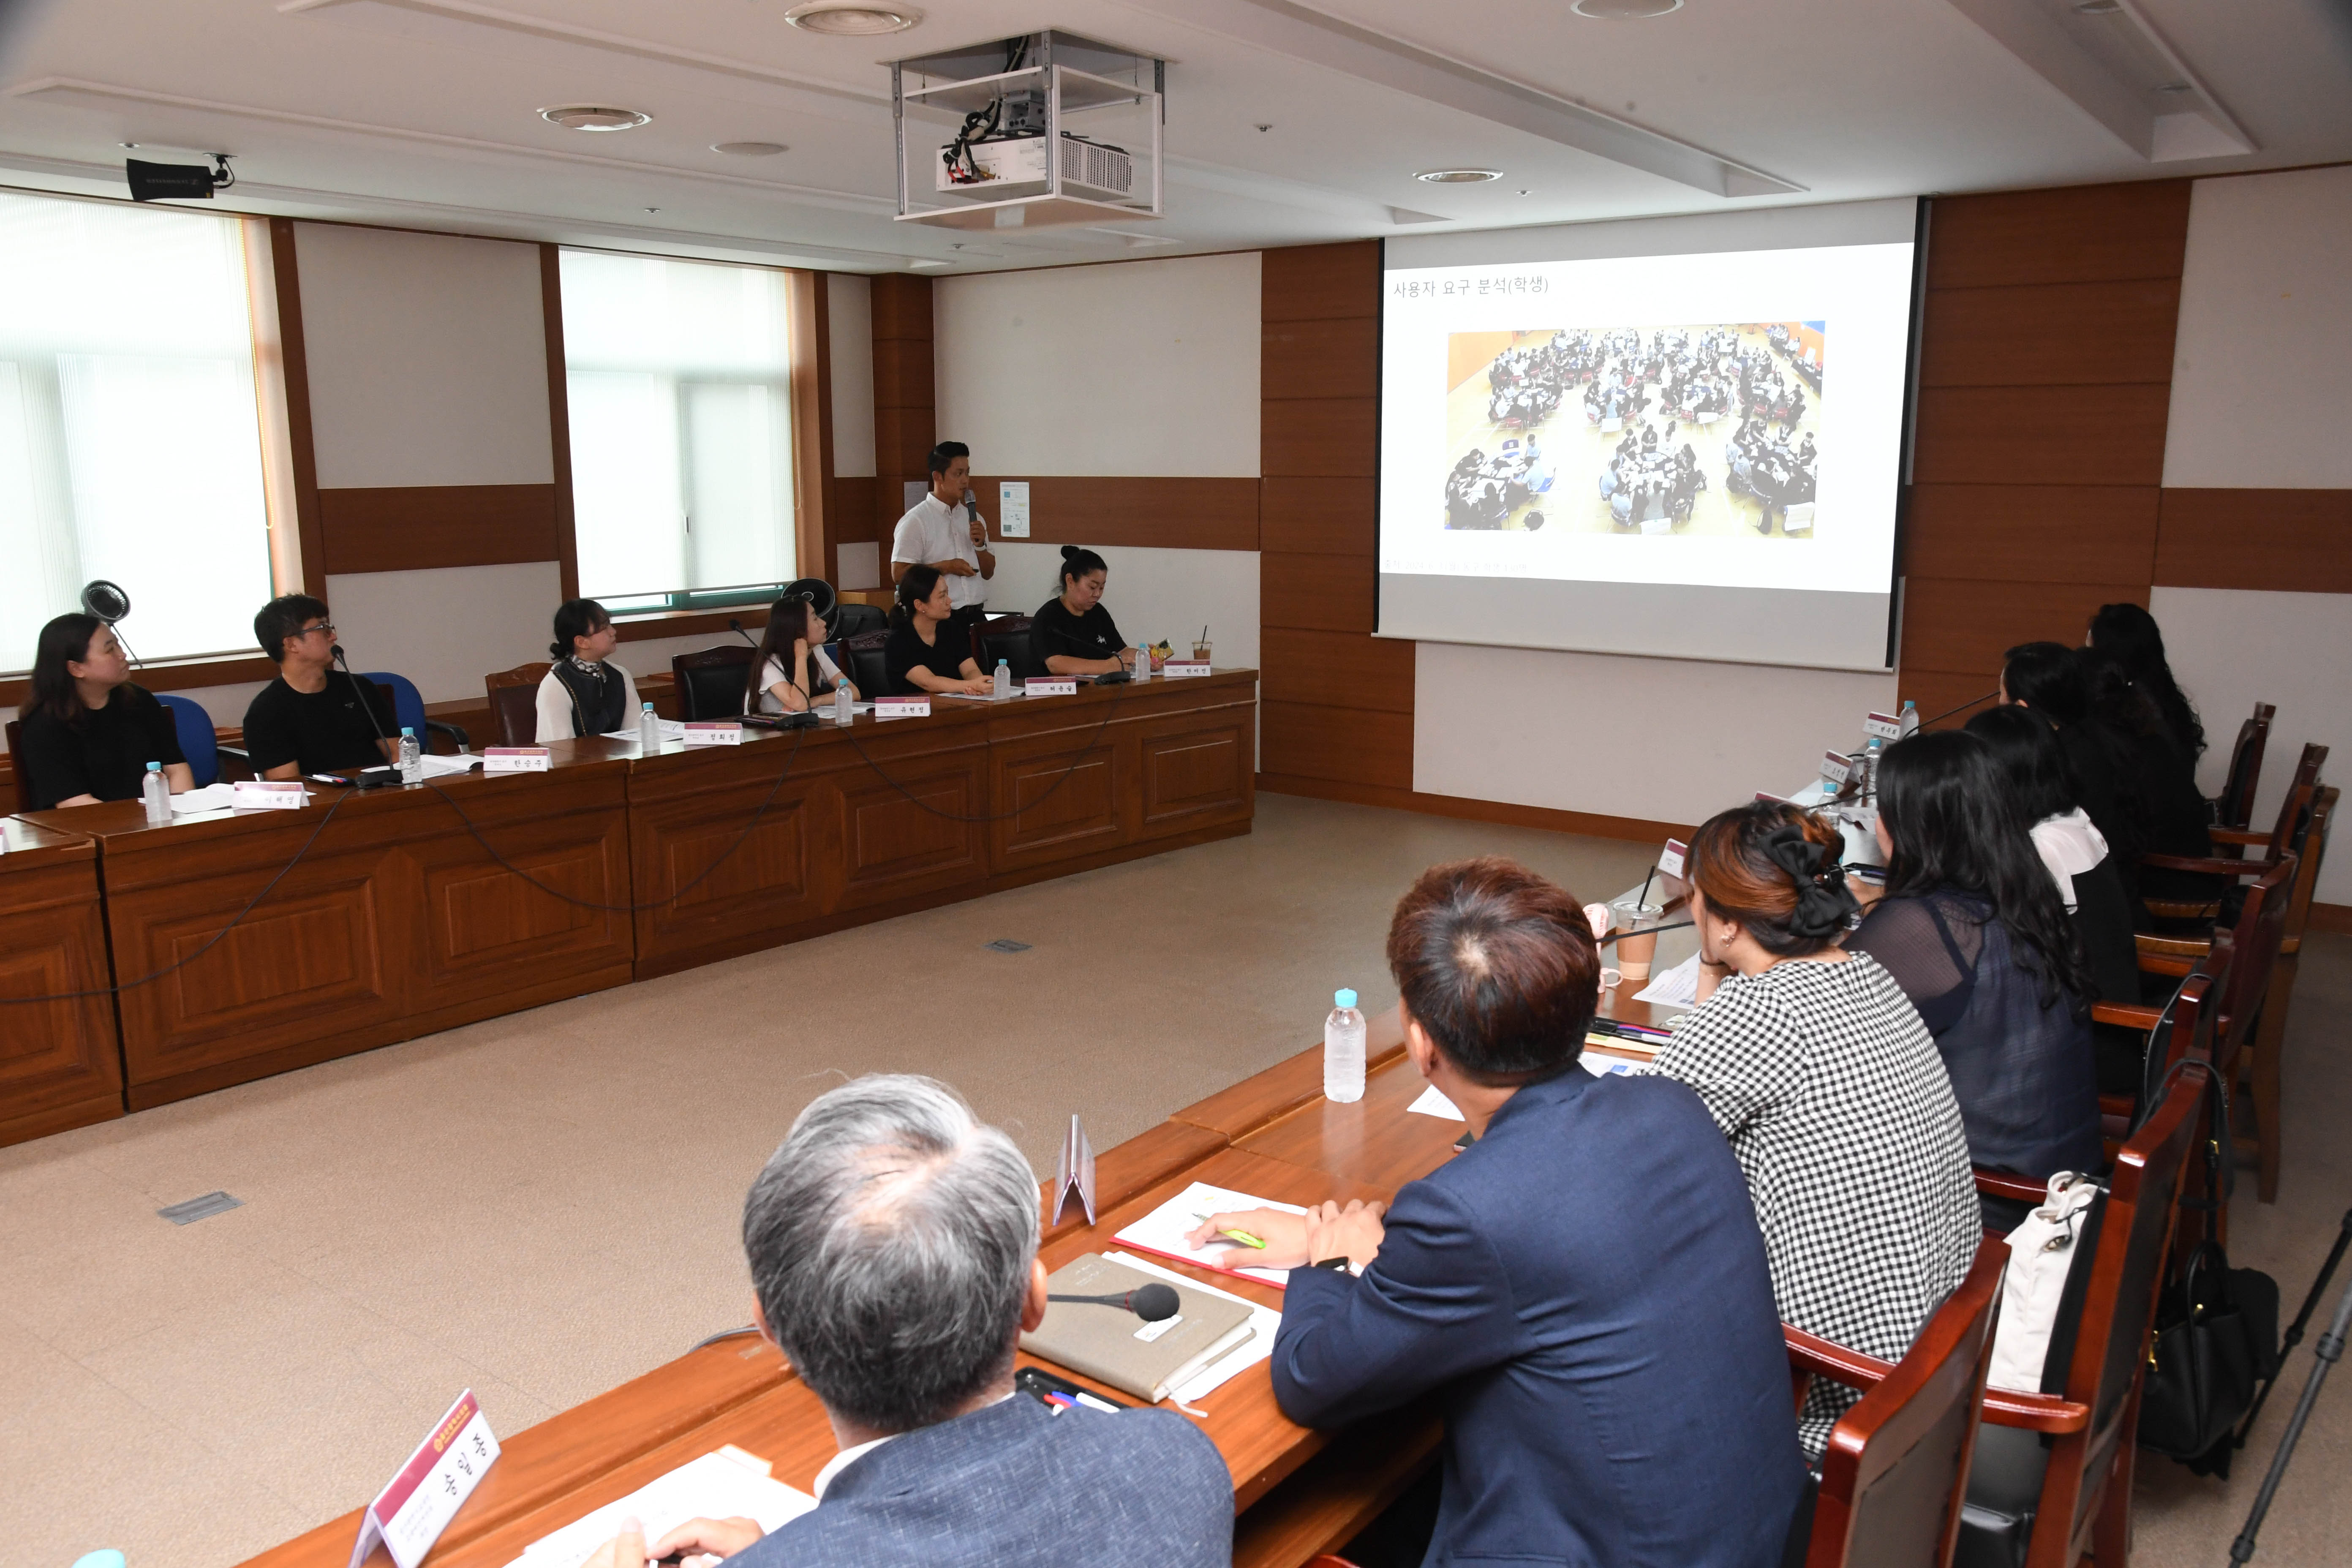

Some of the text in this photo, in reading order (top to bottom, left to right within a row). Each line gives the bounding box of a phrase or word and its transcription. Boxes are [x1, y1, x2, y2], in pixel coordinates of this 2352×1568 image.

[1394, 275, 1548, 298] 사용자 요구 분석(학생)
[445, 1433, 487, 1495] 송일종
